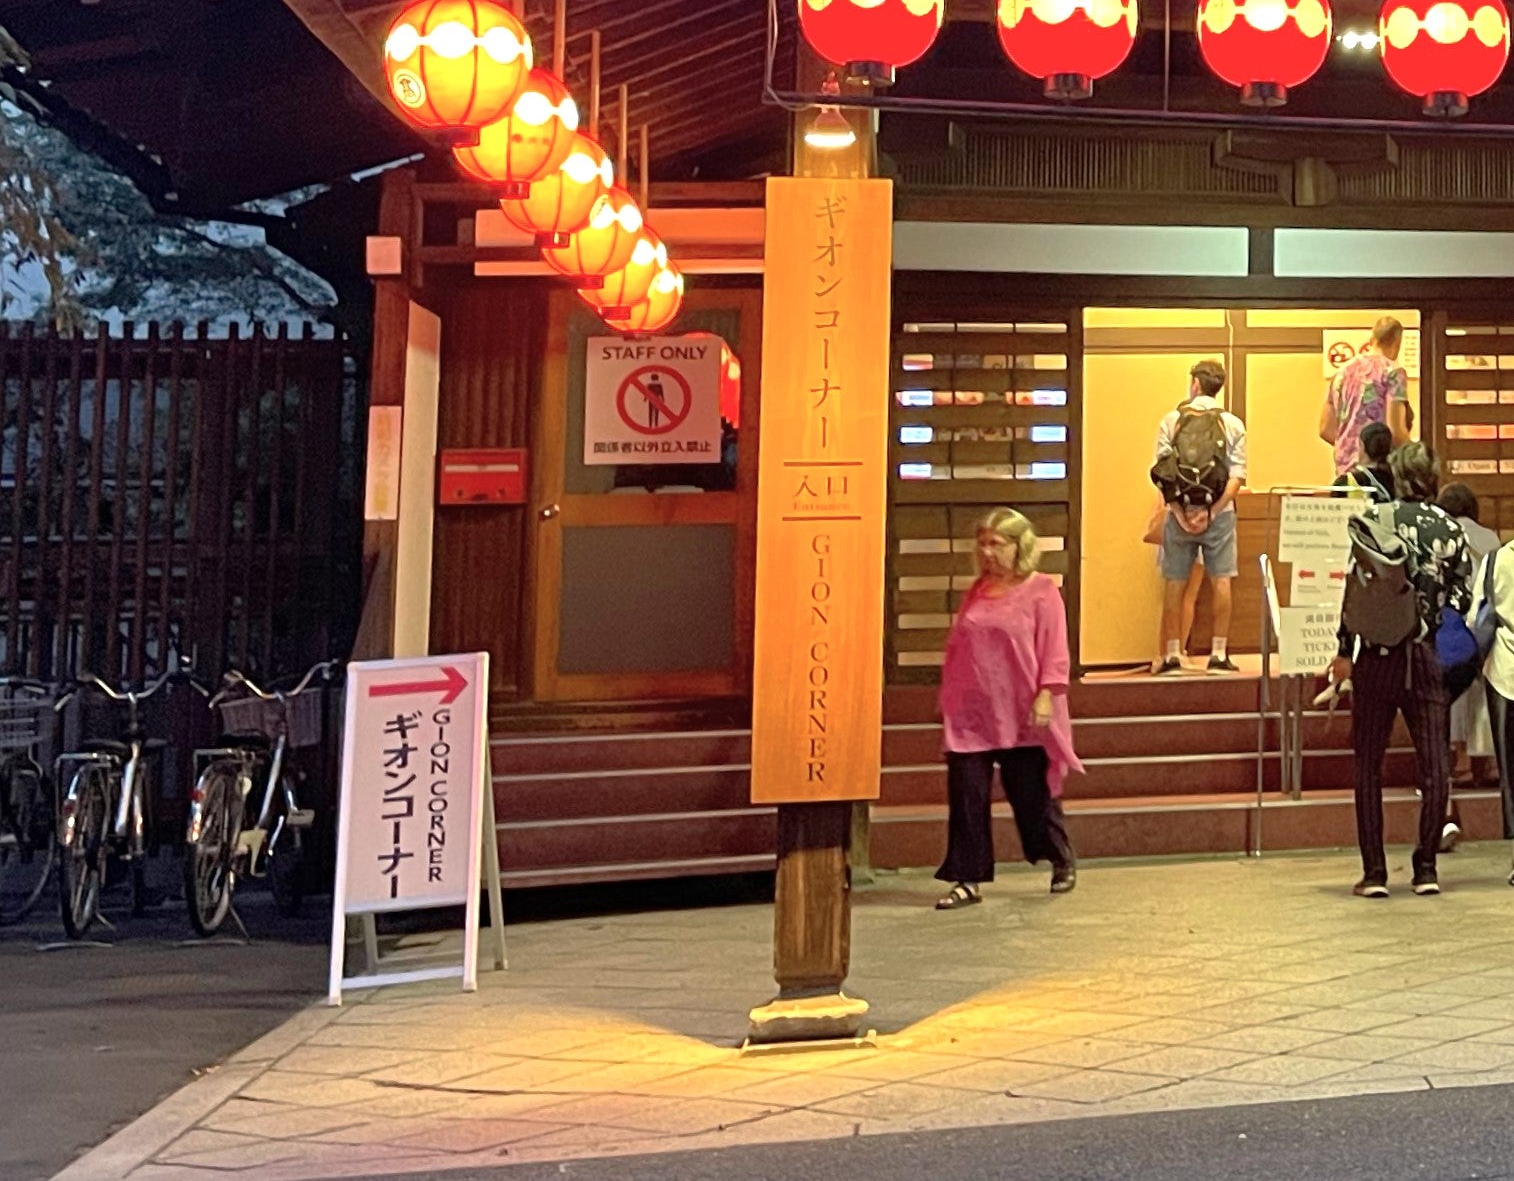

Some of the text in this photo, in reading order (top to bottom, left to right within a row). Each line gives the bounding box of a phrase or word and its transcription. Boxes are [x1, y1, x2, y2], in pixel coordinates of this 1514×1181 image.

[602, 345, 708, 360] STAFF ONLY
[809, 196, 847, 449] ギオンコーナー
[593, 440, 712, 453] 関係者以外立入禁止
[792, 475, 848, 497] 入口
[806, 534, 831, 783] GION CORNER
[1296, 655, 1328, 667] SOLD
[377, 710, 423, 899] ギオンコーナー
[427, 708, 451, 883] GION CORNER
